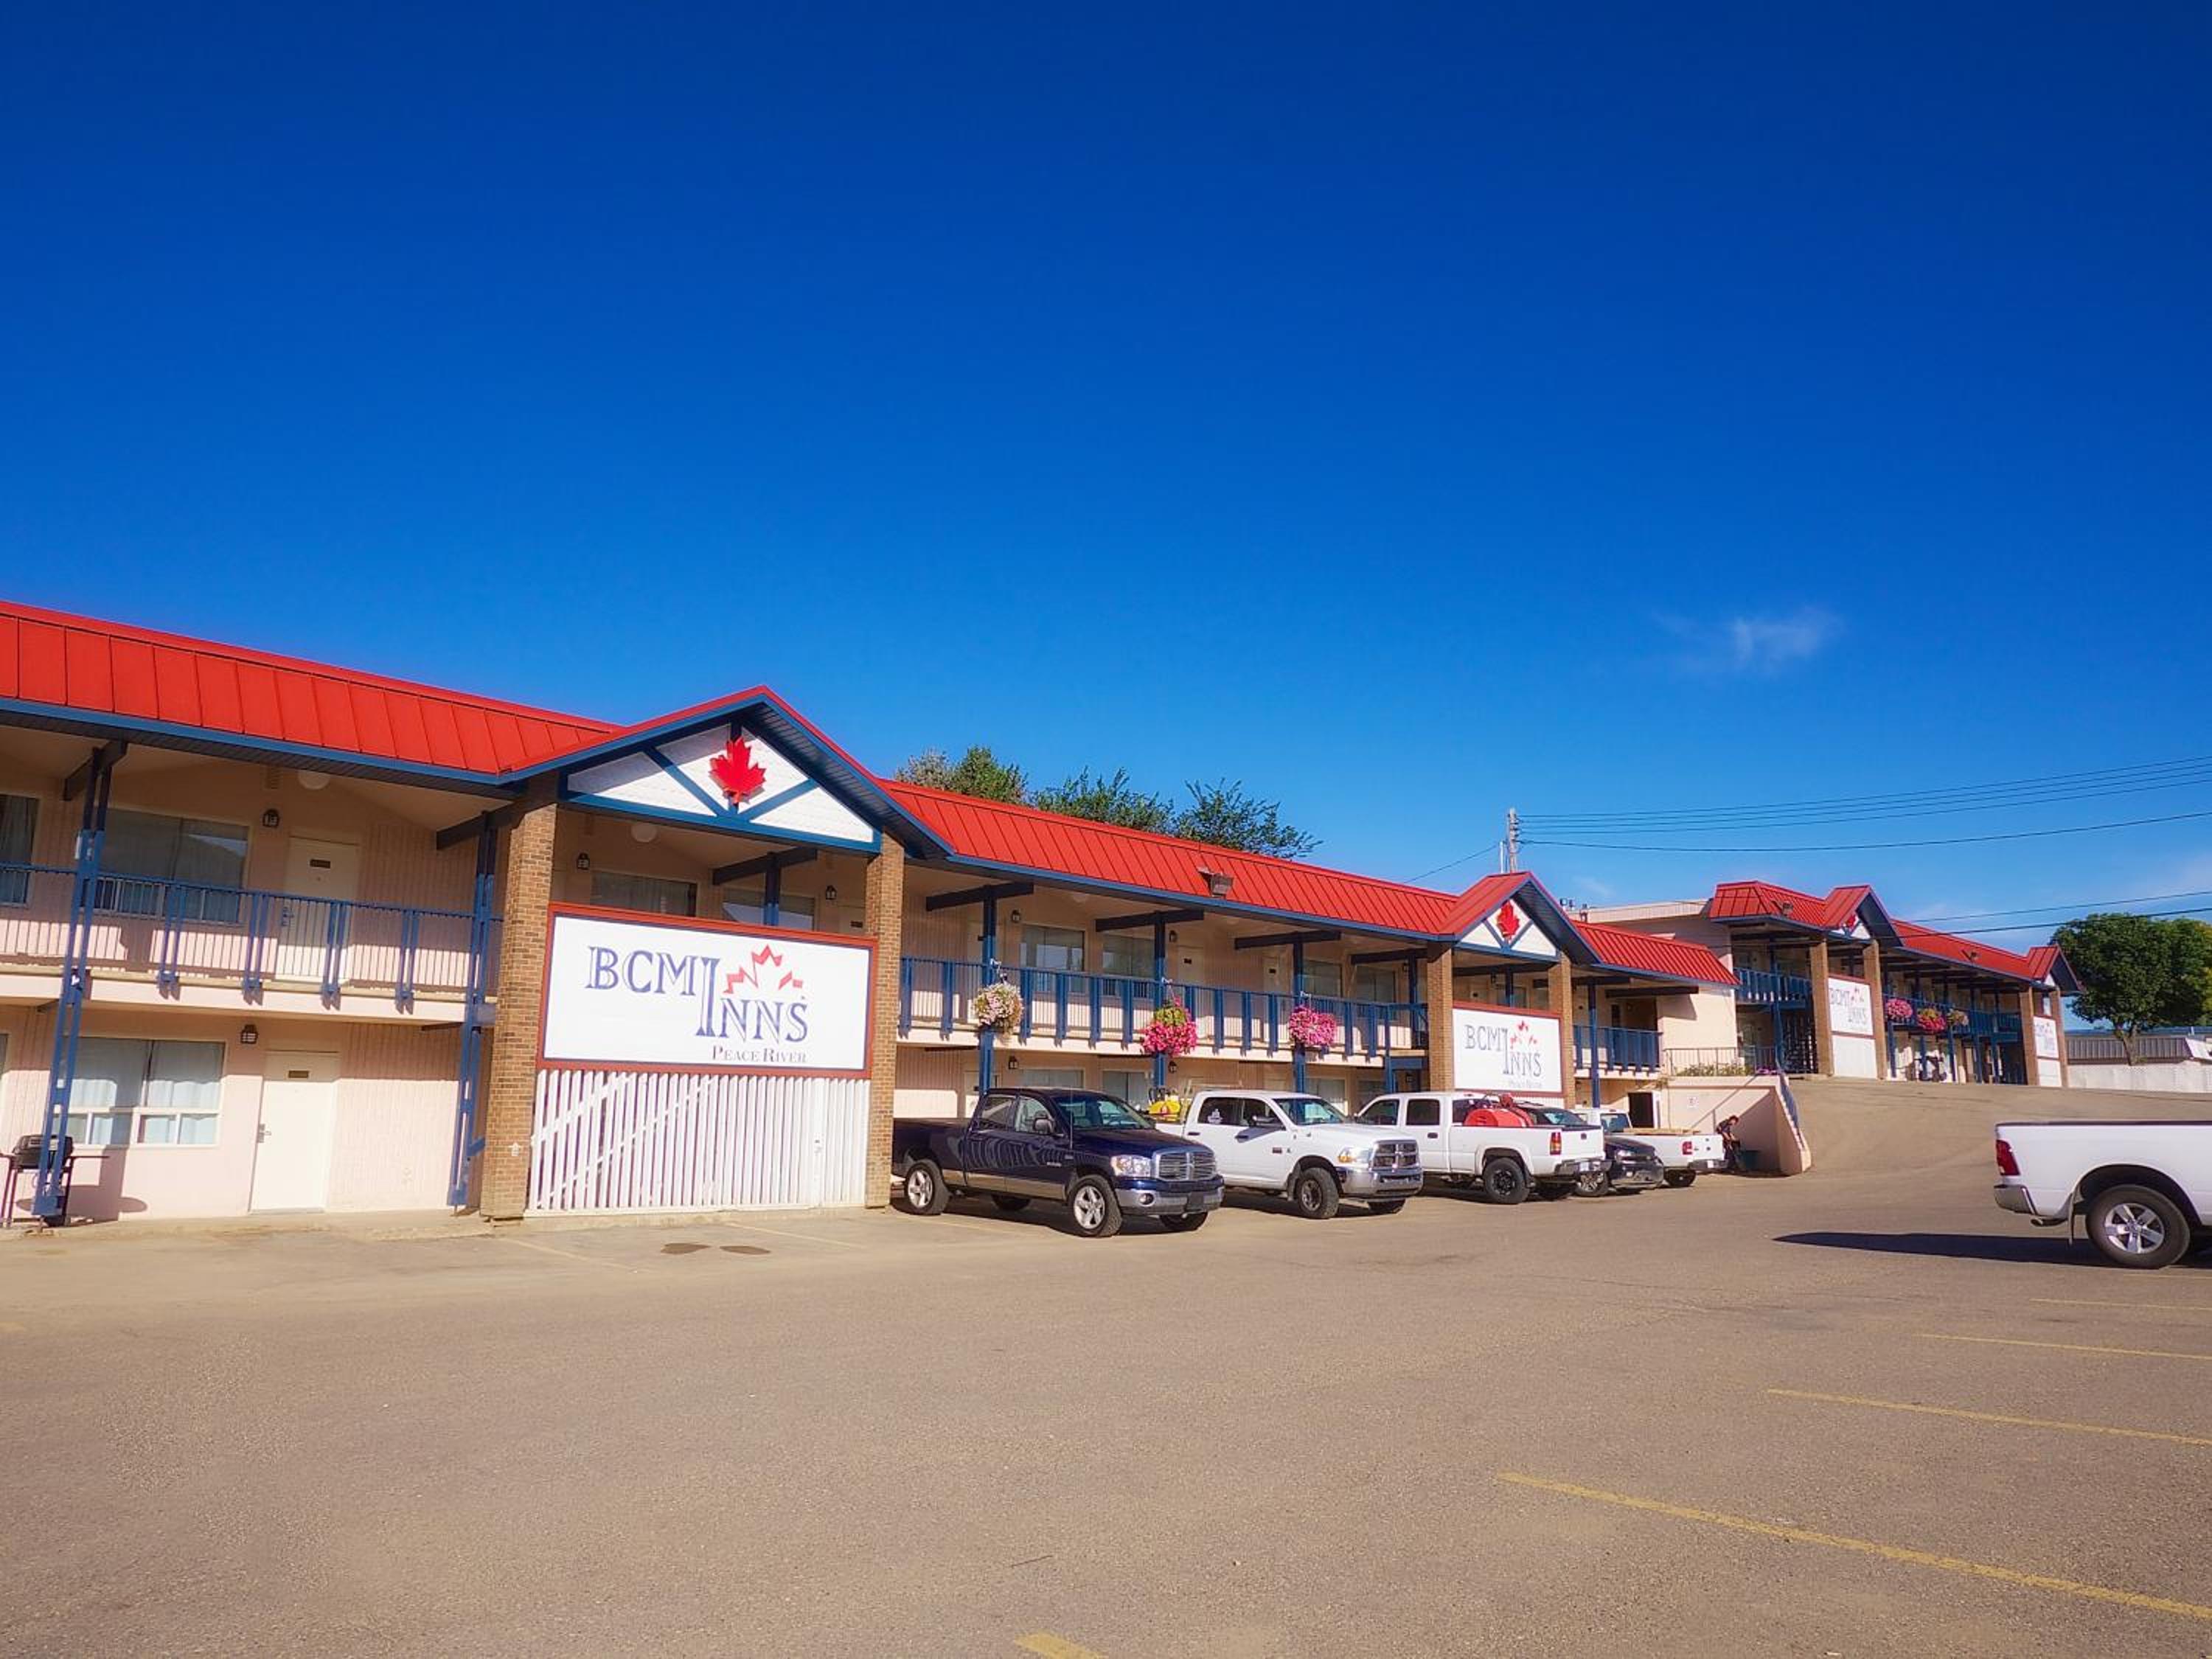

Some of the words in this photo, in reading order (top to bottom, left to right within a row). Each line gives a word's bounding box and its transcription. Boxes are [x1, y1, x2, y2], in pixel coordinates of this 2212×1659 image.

[585, 946, 698, 996] BCM
[695, 957, 808, 1043] INNS
[712, 1045, 760, 1062] PEACE
[763, 1048, 808, 1063] RIVER
[1464, 1024, 1502, 1051] BCM
[1501, 1028, 1543, 1077] INNS
